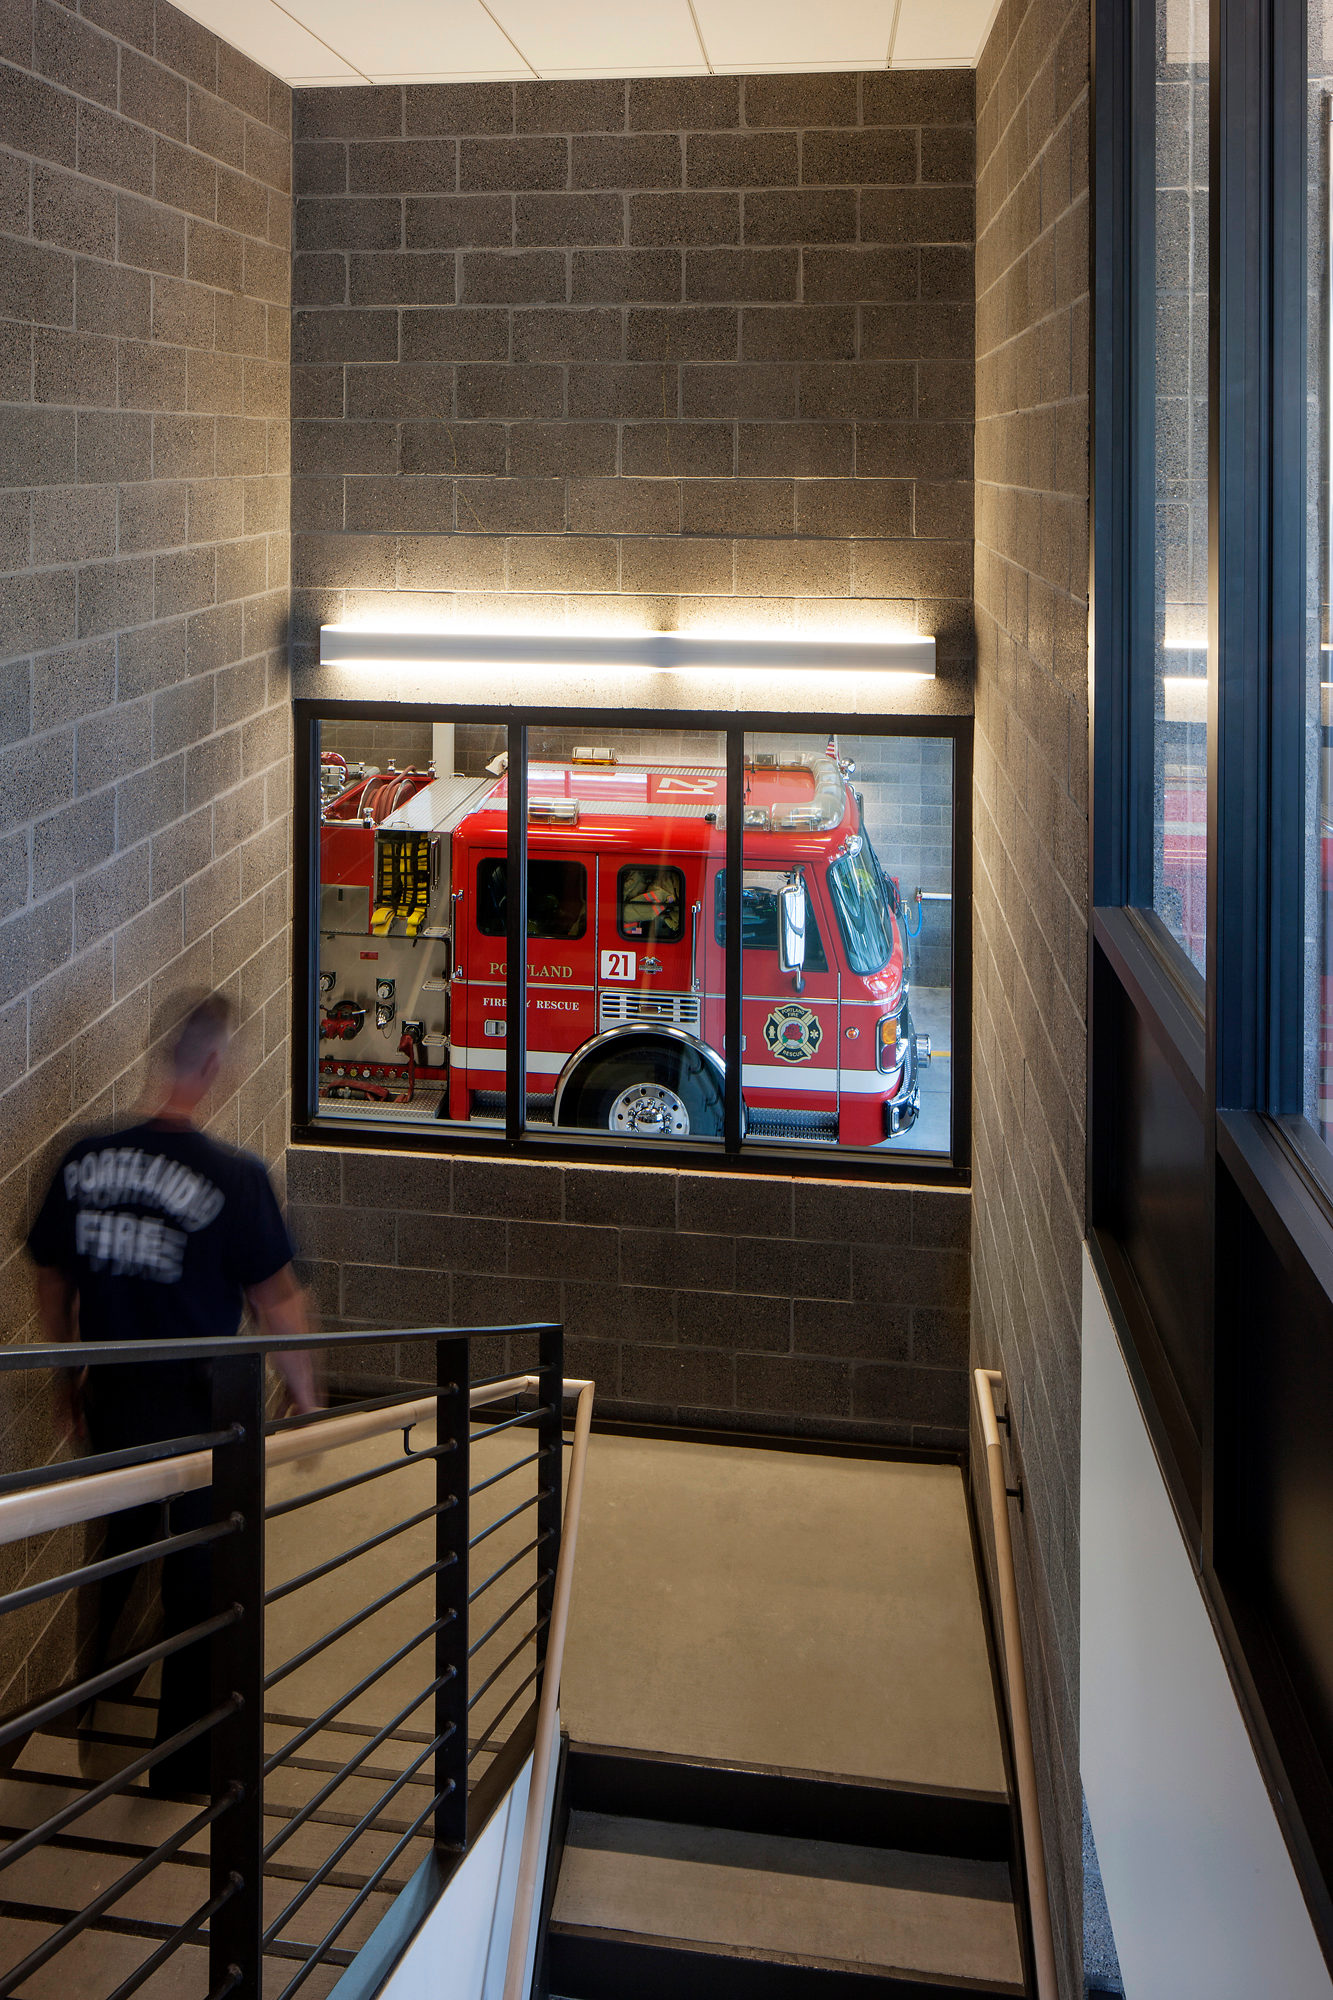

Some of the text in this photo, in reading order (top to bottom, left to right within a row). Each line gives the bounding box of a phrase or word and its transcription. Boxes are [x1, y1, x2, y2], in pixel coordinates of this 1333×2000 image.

[489, 962, 573, 978] POLAND
[608, 953, 629, 977] 21
[537, 1000, 580, 1011] RESCUE
[781, 1007, 805, 1015] PORTLAND
[782, 1049, 804, 1057] RESCUE
[76, 1210, 188, 1284] FIRE
